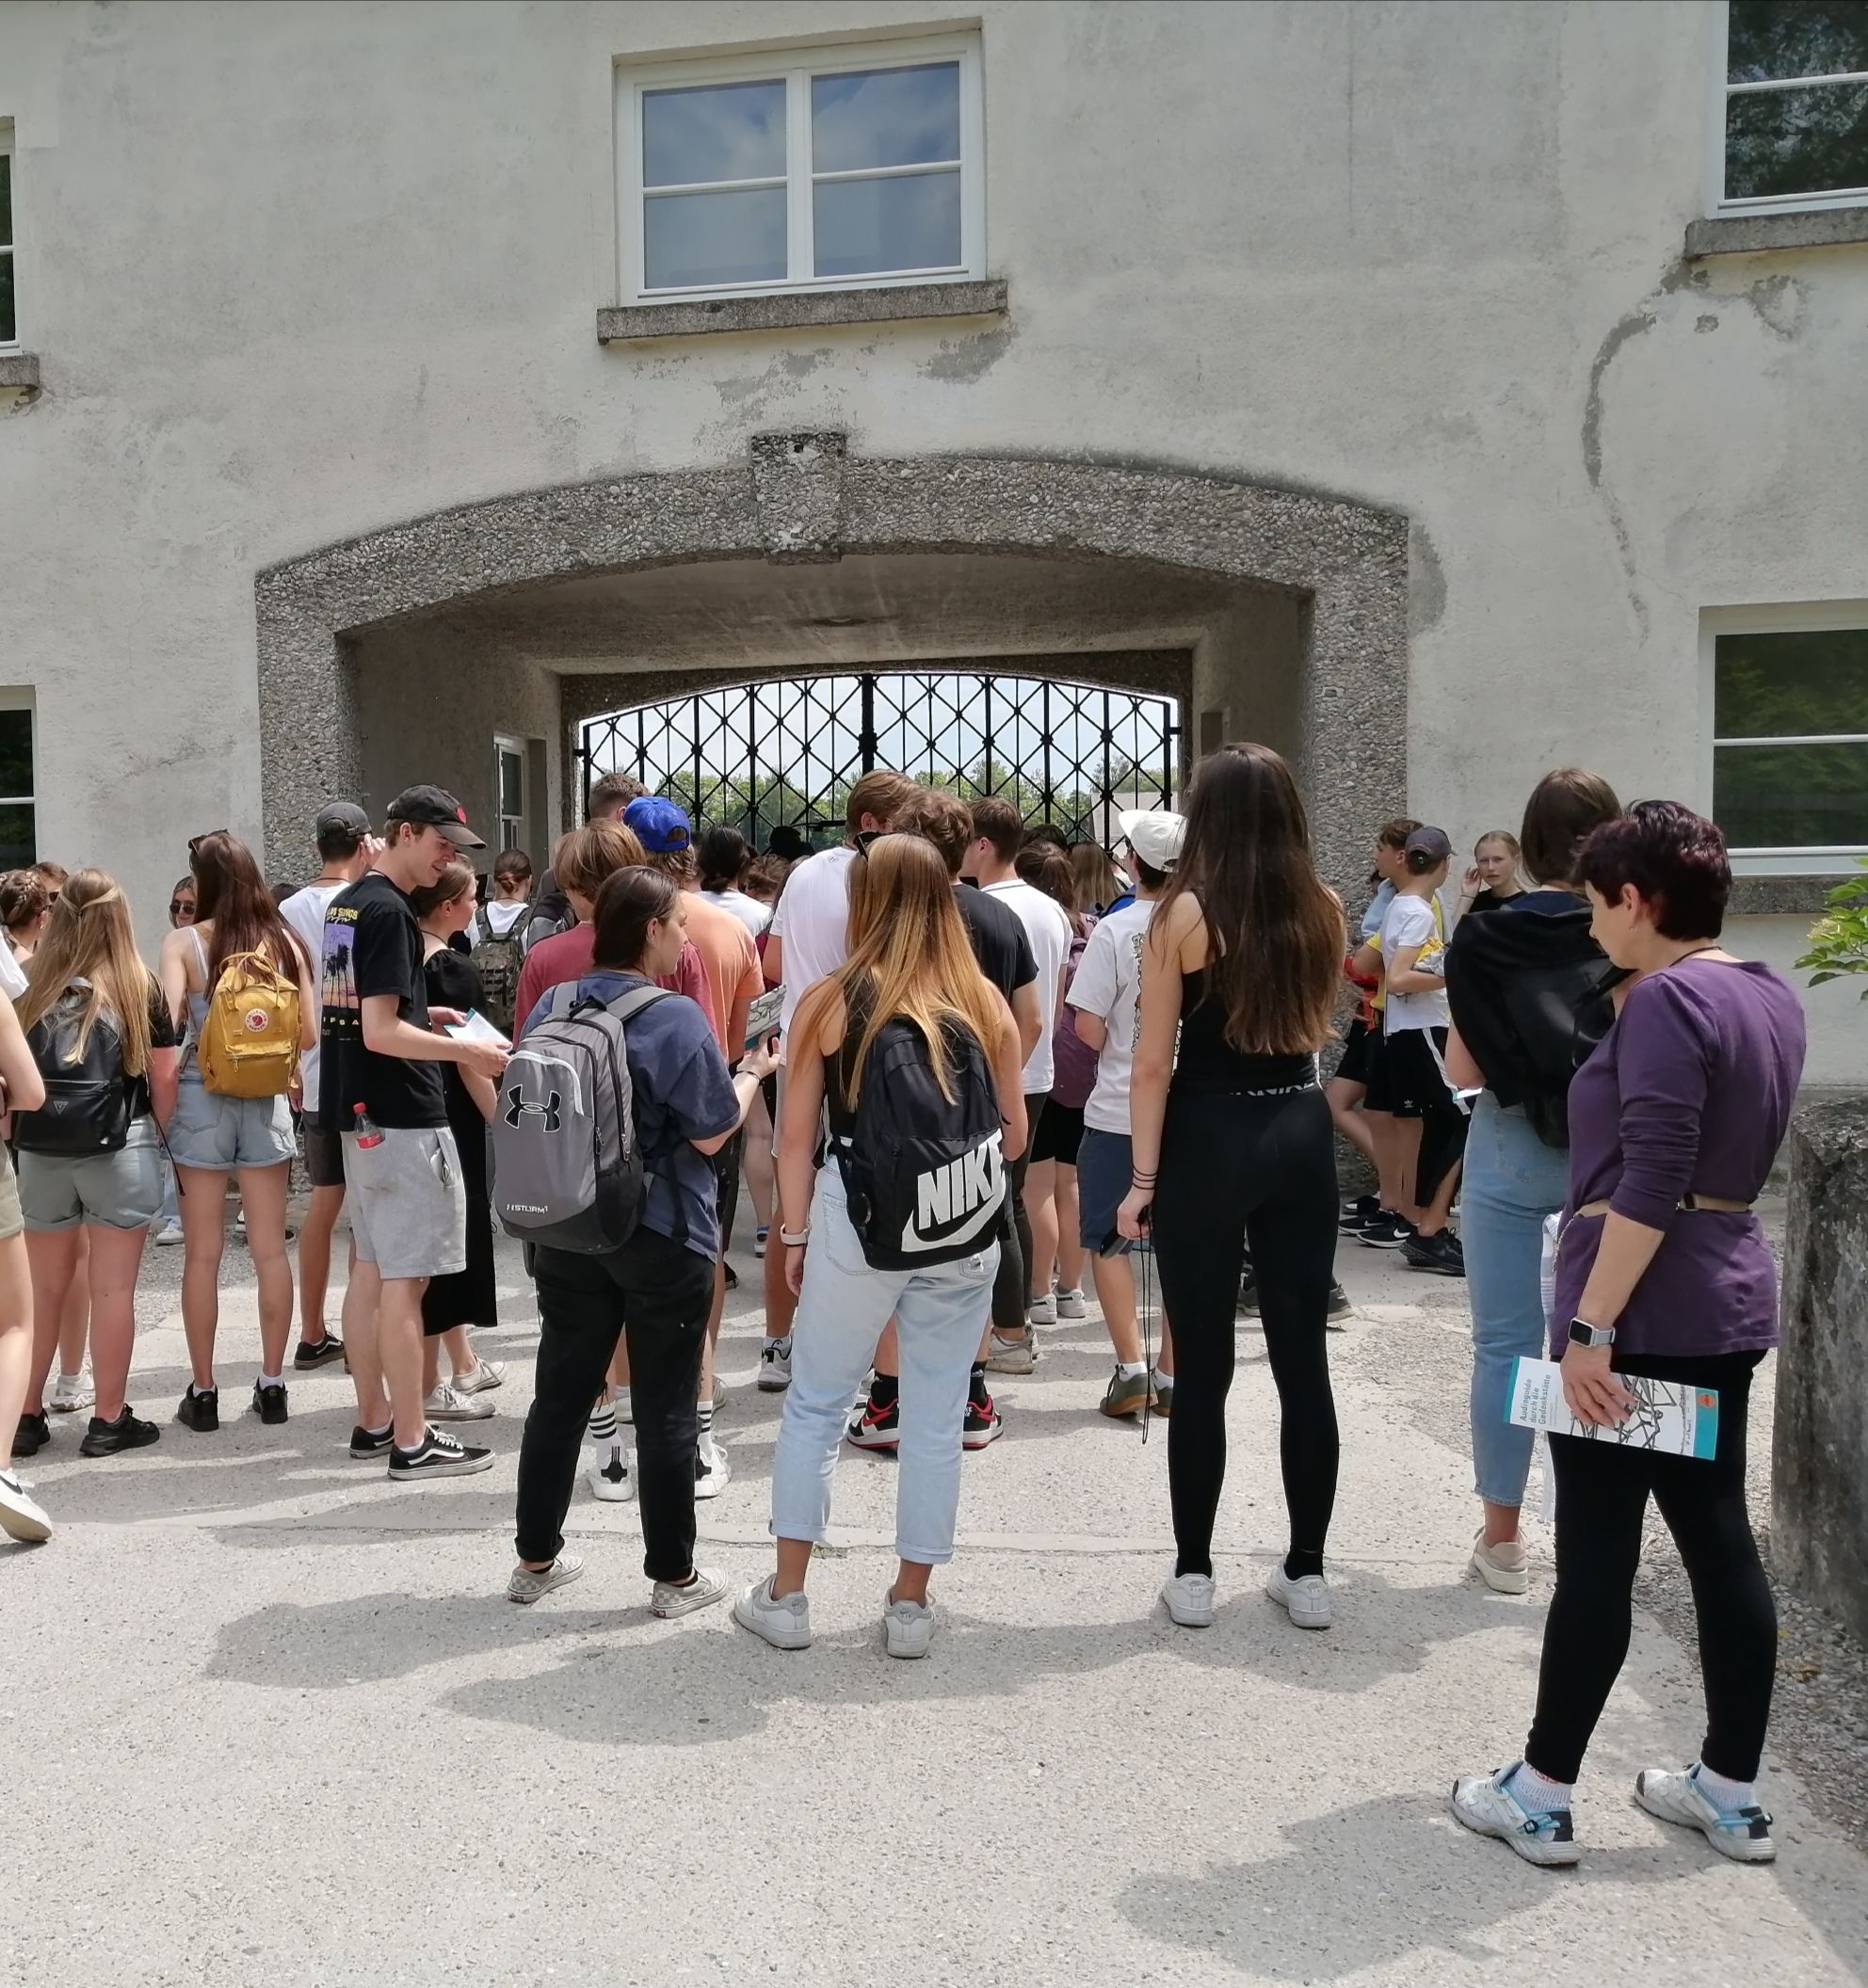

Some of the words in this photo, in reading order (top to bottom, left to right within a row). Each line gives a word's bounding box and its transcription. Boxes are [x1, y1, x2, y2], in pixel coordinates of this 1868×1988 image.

[1520, 1378, 1532, 1422] Audioguide
[1531, 1387, 1539, 1400] die
[1529, 1401, 1538, 1423] durch
